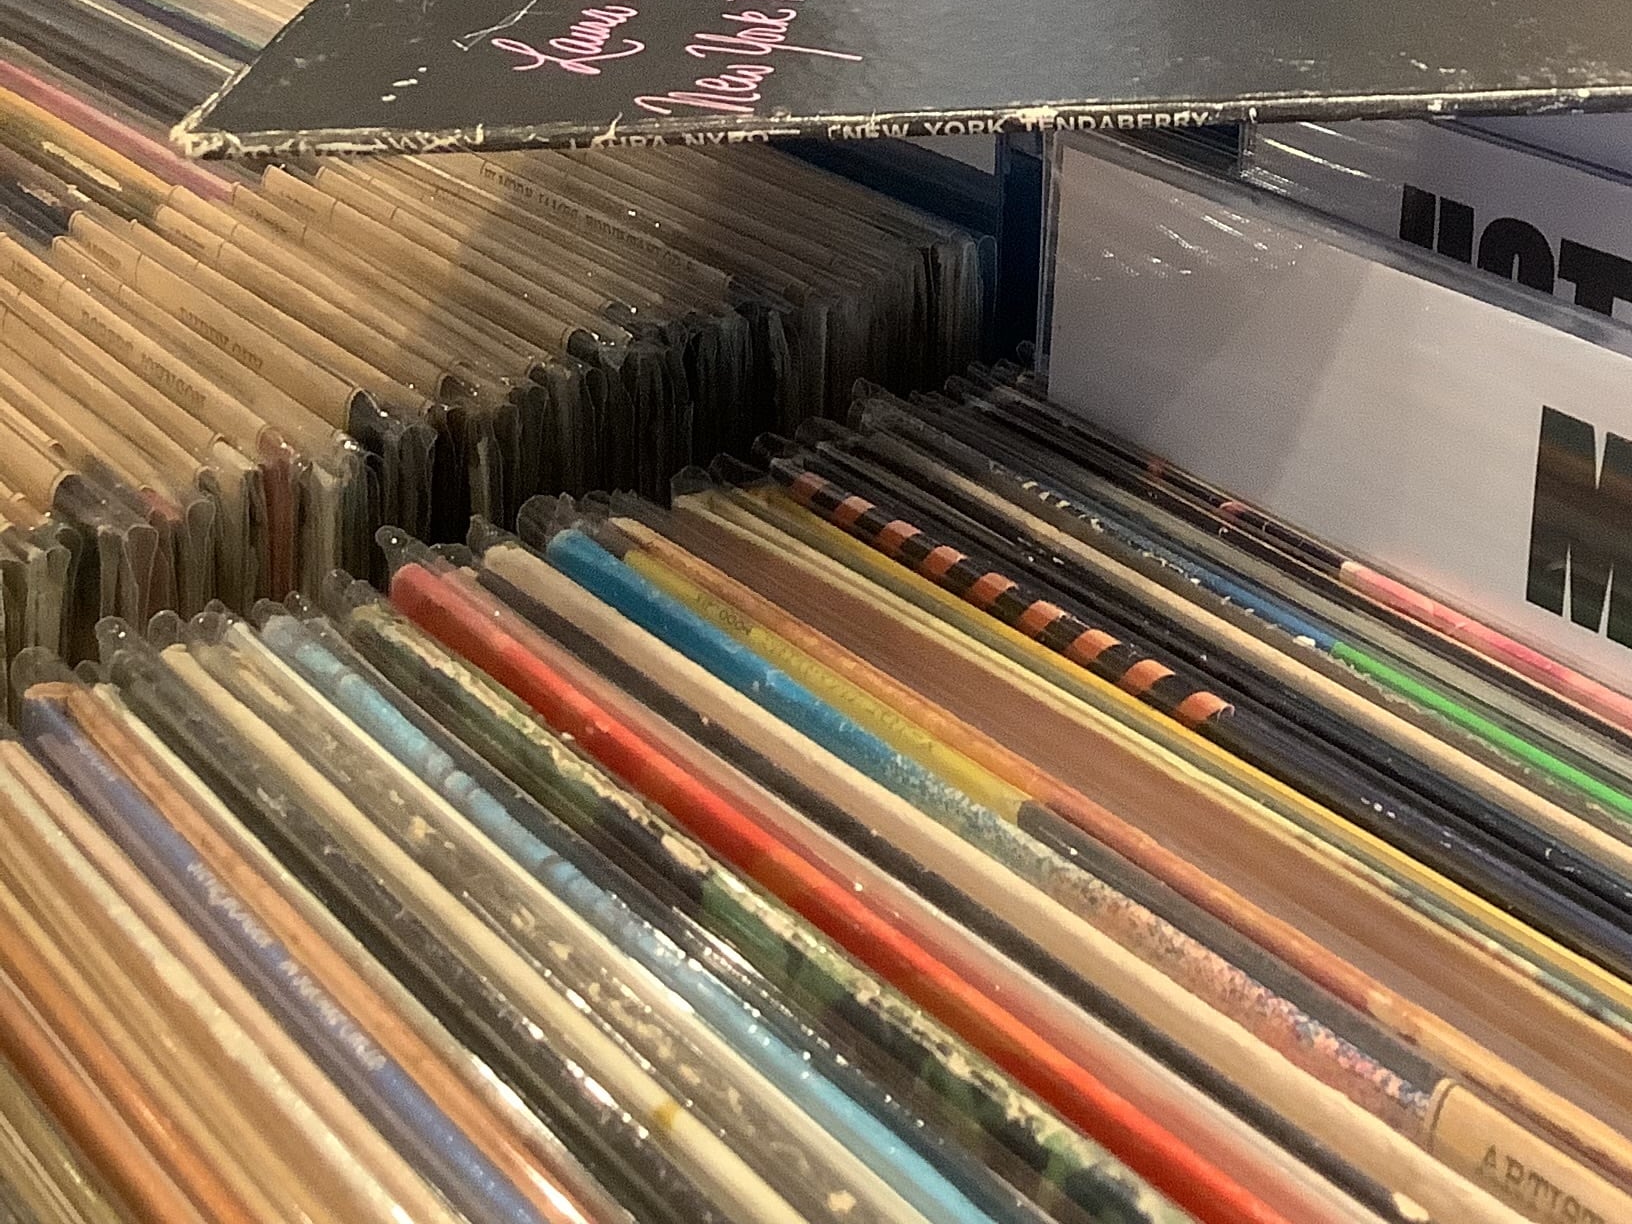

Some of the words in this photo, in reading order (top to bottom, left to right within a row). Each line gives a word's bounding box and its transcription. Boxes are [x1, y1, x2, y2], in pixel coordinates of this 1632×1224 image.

[490, 5, 646, 75] Laura
[684, 7, 864, 62] York
[633, 63, 776, 116] New
[924, 117, 1006, 137] YORK
[1018, 109, 1210, 133] TENDABERRY
